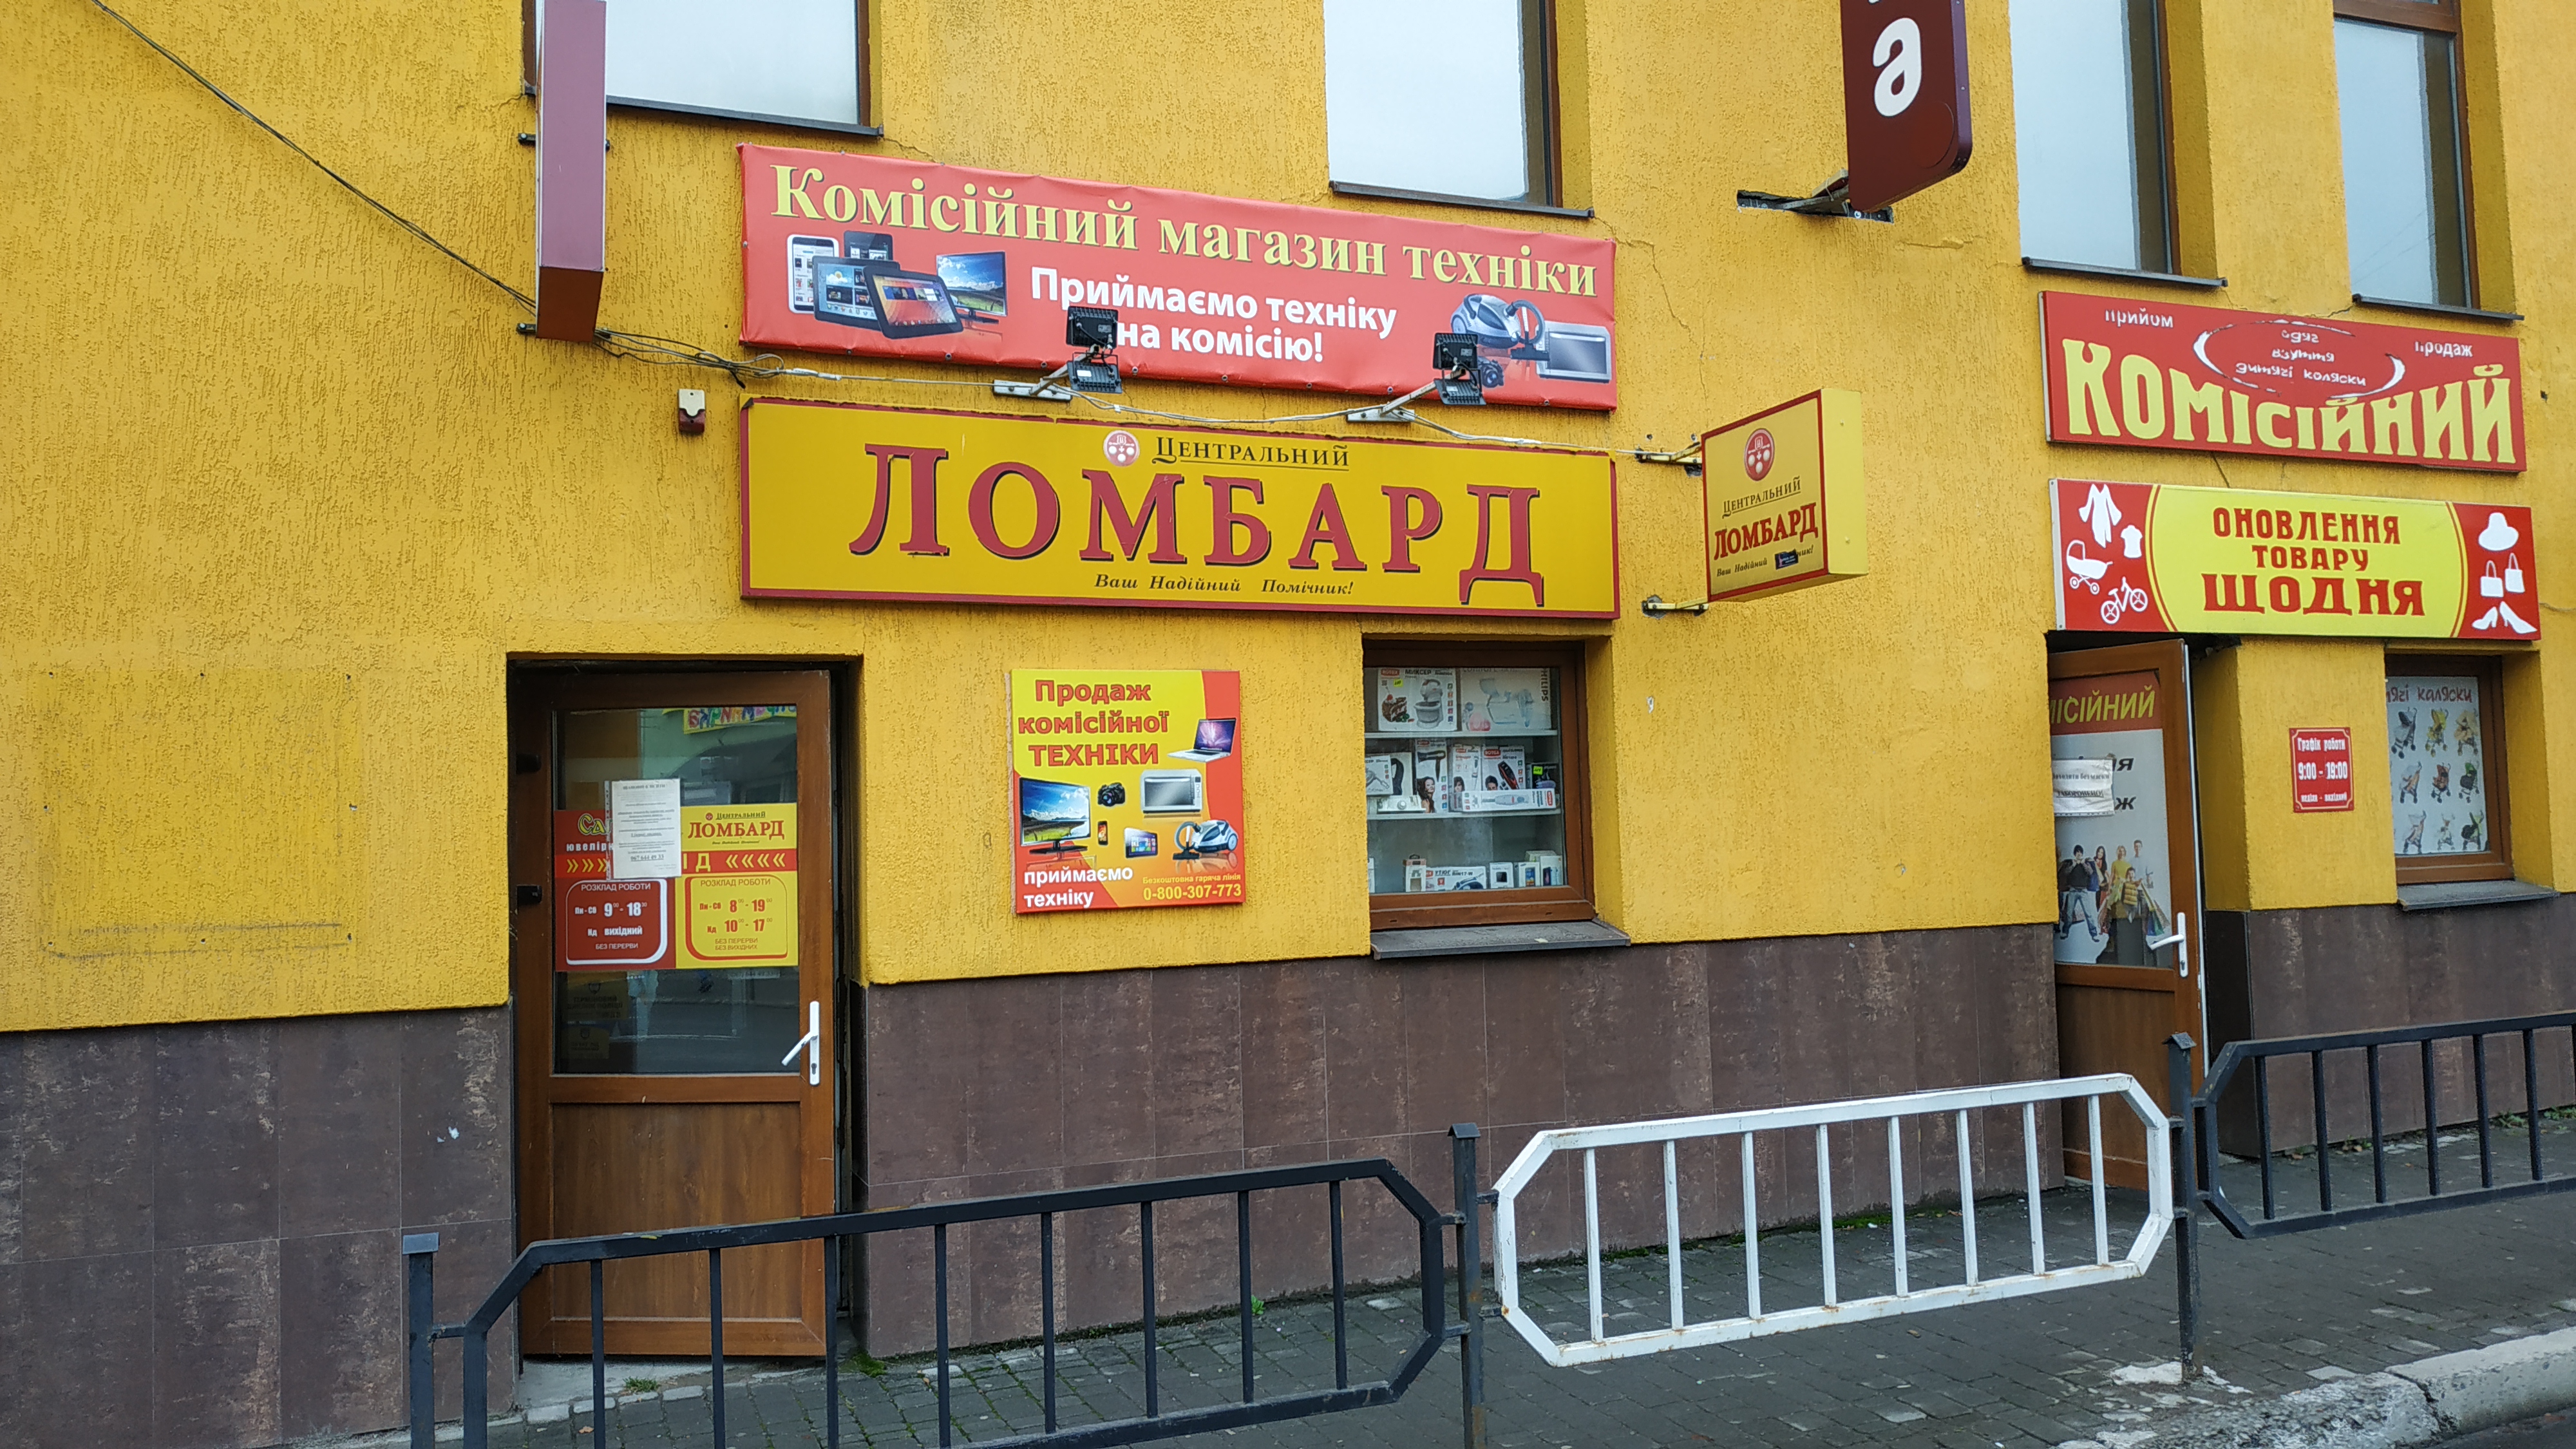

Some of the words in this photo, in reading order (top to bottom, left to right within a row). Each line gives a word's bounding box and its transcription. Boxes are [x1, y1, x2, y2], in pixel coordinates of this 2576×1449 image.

[770, 165, 1139, 251] Комісійний
[1159, 218, 1387, 276] магазин
[1403, 245, 1598, 298] техніки
[1032, 267, 1257, 319] Приймаємо
[1265, 296, 1397, 339] техніку
[1117, 322, 1160, 349] на
[1171, 326, 1323, 363] комісію!
[2062, 338, 2516, 464] КОМІСІЙНИЙ
[848, 442, 1544, 607] ЛОМБАРД
[1714, 502, 1818, 560] ЛОМБАРД
[2213, 507, 2400, 545] ОНОВЛЕННЯ
[1716, 568, 1731, 577] Ваш
[1734, 558, 1768, 573] Надійний
[2251, 545, 2369, 572] ТОВАРУ
[1095, 573, 1139, 590] Ваш
[1149, 574, 1242, 593] Надійний
[1261, 579, 1354, 596] Помічник!
[2201, 573, 2425, 616] ЩОДНЯ
[1035, 679, 1151, 706] Продаж
[1018, 710, 1170, 734] комісійної
[1028, 743, 1159, 767] ТЕХНІКИ
[2297, 737, 2321, 752] Графік
[2324, 737, 2346, 752] роботи
[2298, 762, 2317, 780] 9:00
[2325, 761, 2348, 779] 19:00
[688, 820, 785, 840] ЛОМБАРД
[1024, 866, 1133, 886] приймаємо
[1195, 875, 1221, 883] гаряча
[1222, 873, 1241, 881] лінія
[1024, 889, 1094, 909] техніку
[1143, 884, 1242, 900] 0-800-307-773
[604, 925, 643, 936] вихідний
